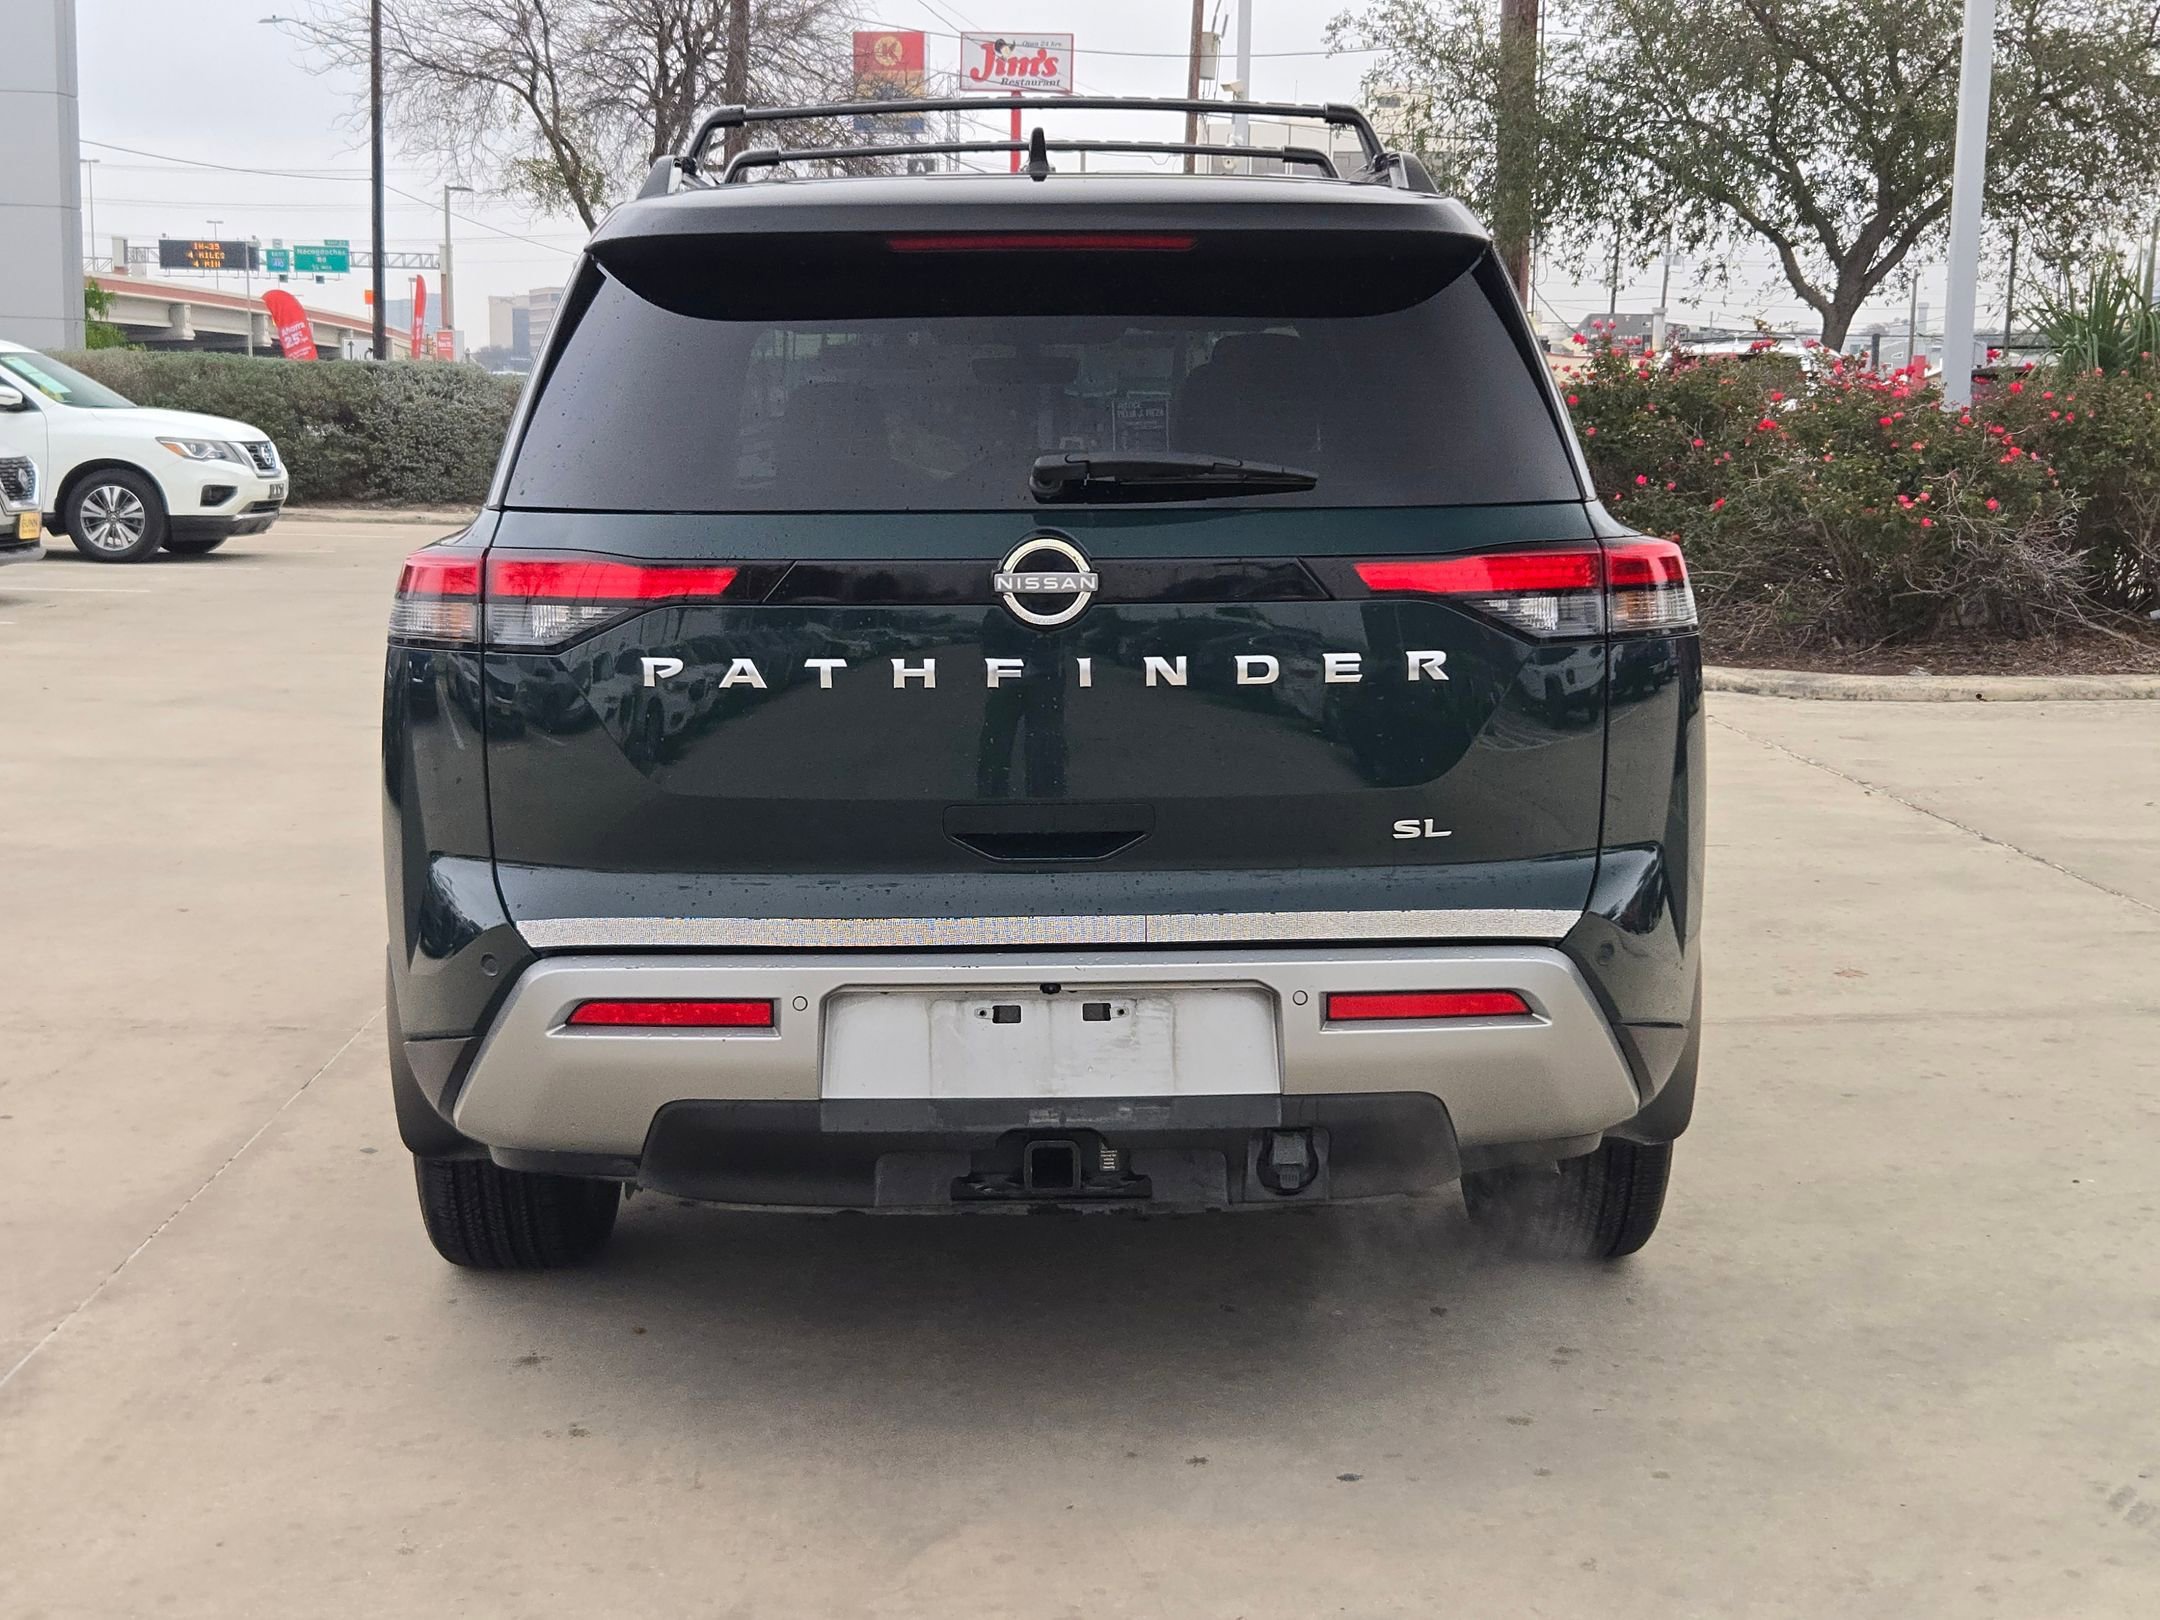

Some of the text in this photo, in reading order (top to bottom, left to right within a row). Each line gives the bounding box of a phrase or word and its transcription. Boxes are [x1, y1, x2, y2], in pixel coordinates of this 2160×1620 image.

[969, 43, 1059, 82] Jim's
[1000, 77, 1060, 87] Restaurant
[997, 577, 1096, 590] NISSAN
[640, 650, 1449, 689] PATHFINDER
[1392, 818, 1453, 839] SL
